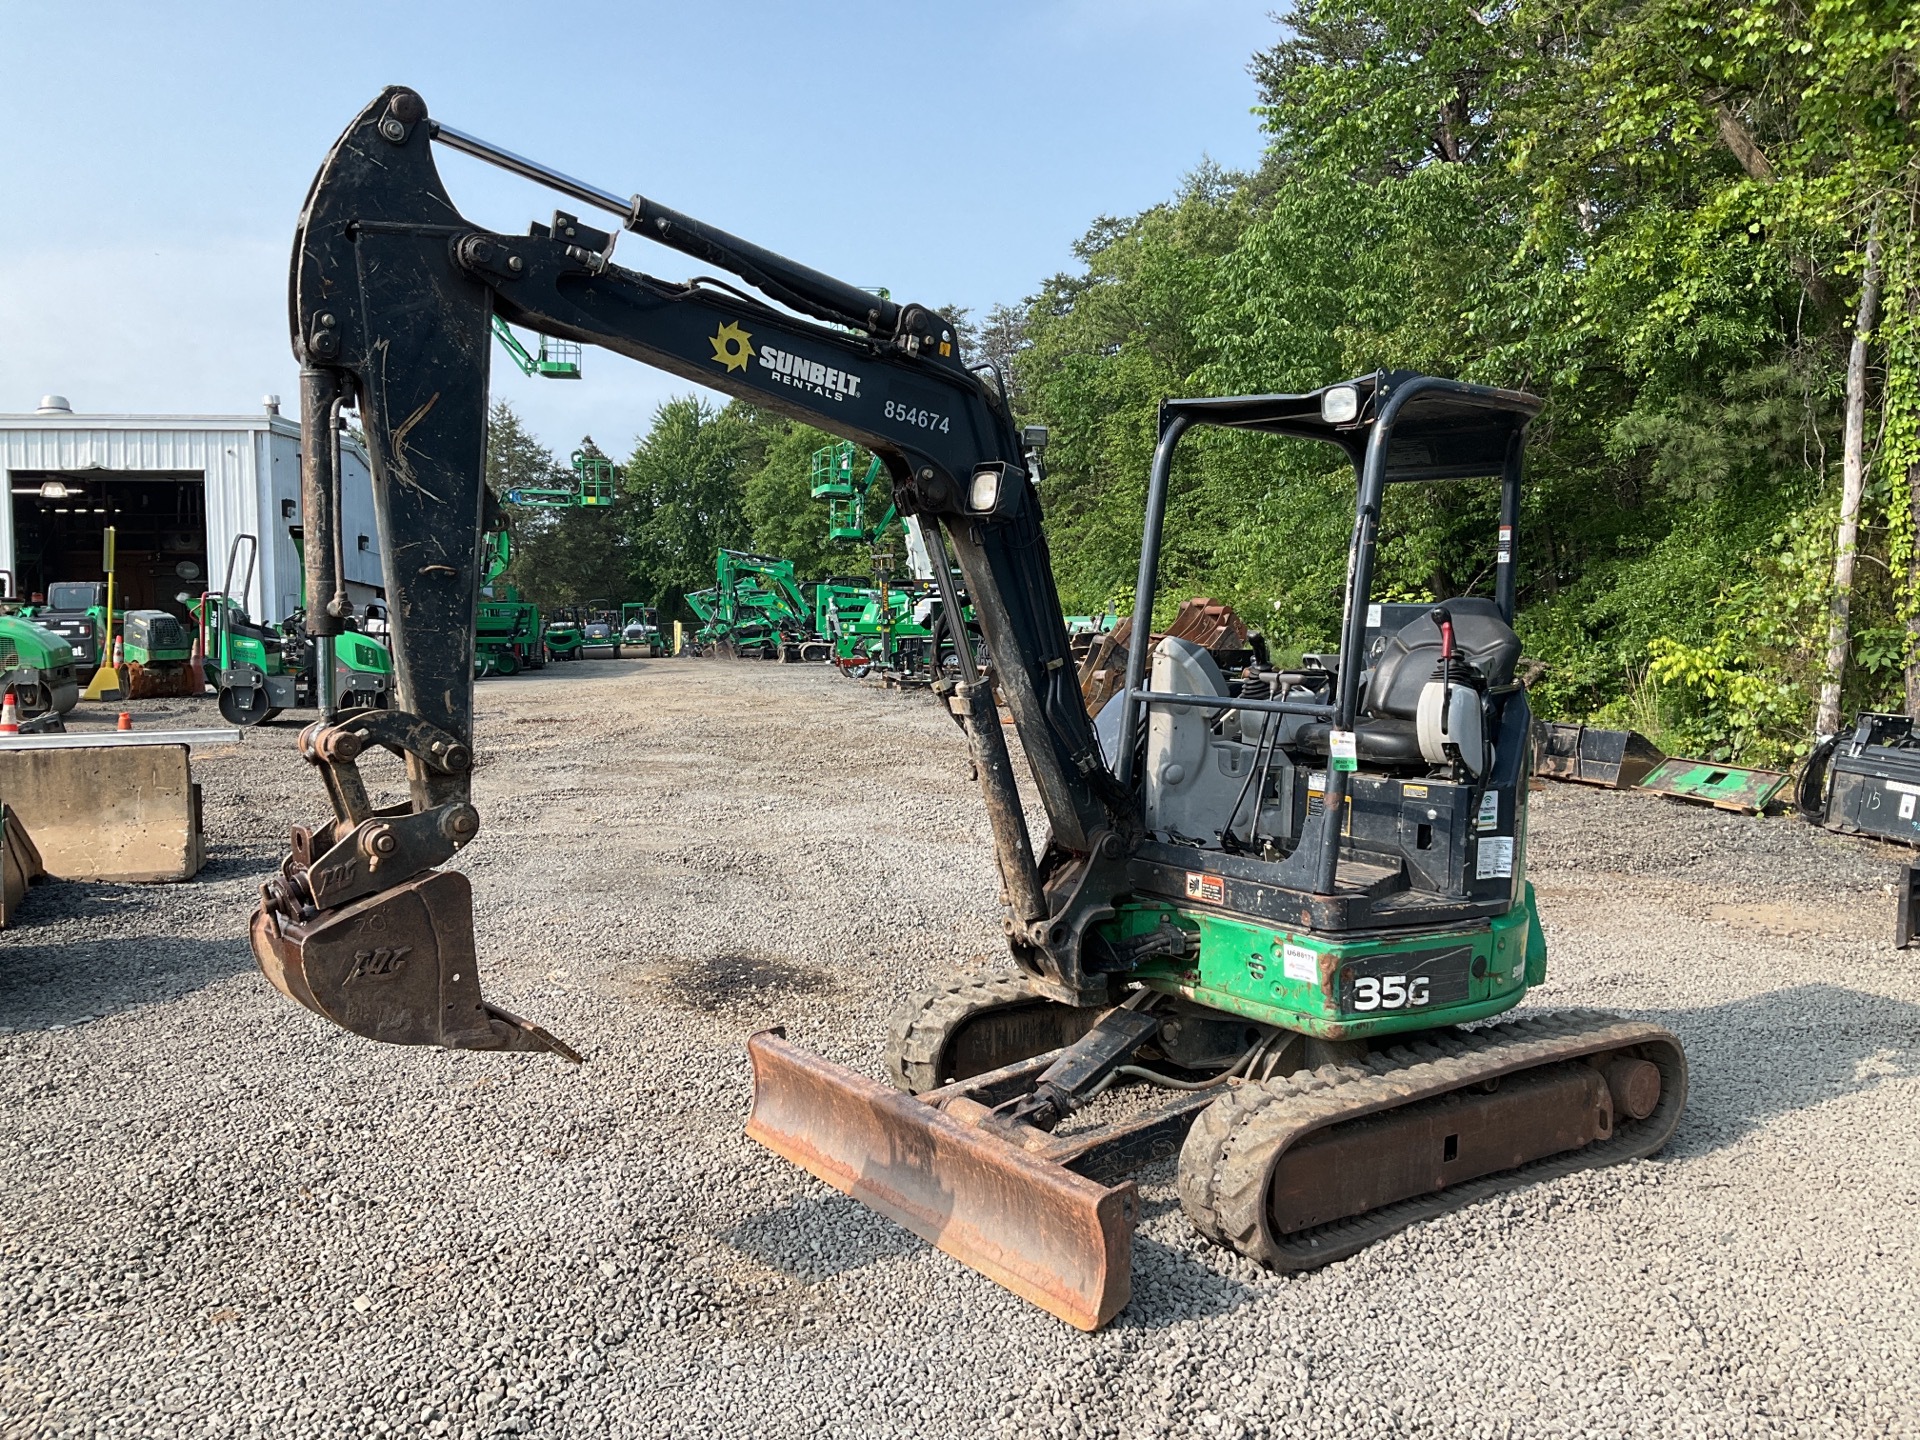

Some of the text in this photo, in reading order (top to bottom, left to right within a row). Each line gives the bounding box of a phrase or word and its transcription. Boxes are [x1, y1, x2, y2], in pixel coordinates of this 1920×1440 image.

[759, 345, 860, 397] SUNBELT
[771, 371, 844, 402] RENTALS
[884, 400, 950, 434] 854674
[1866, 787, 1882, 810] 15
[1353, 975, 1430, 1011] 35G
